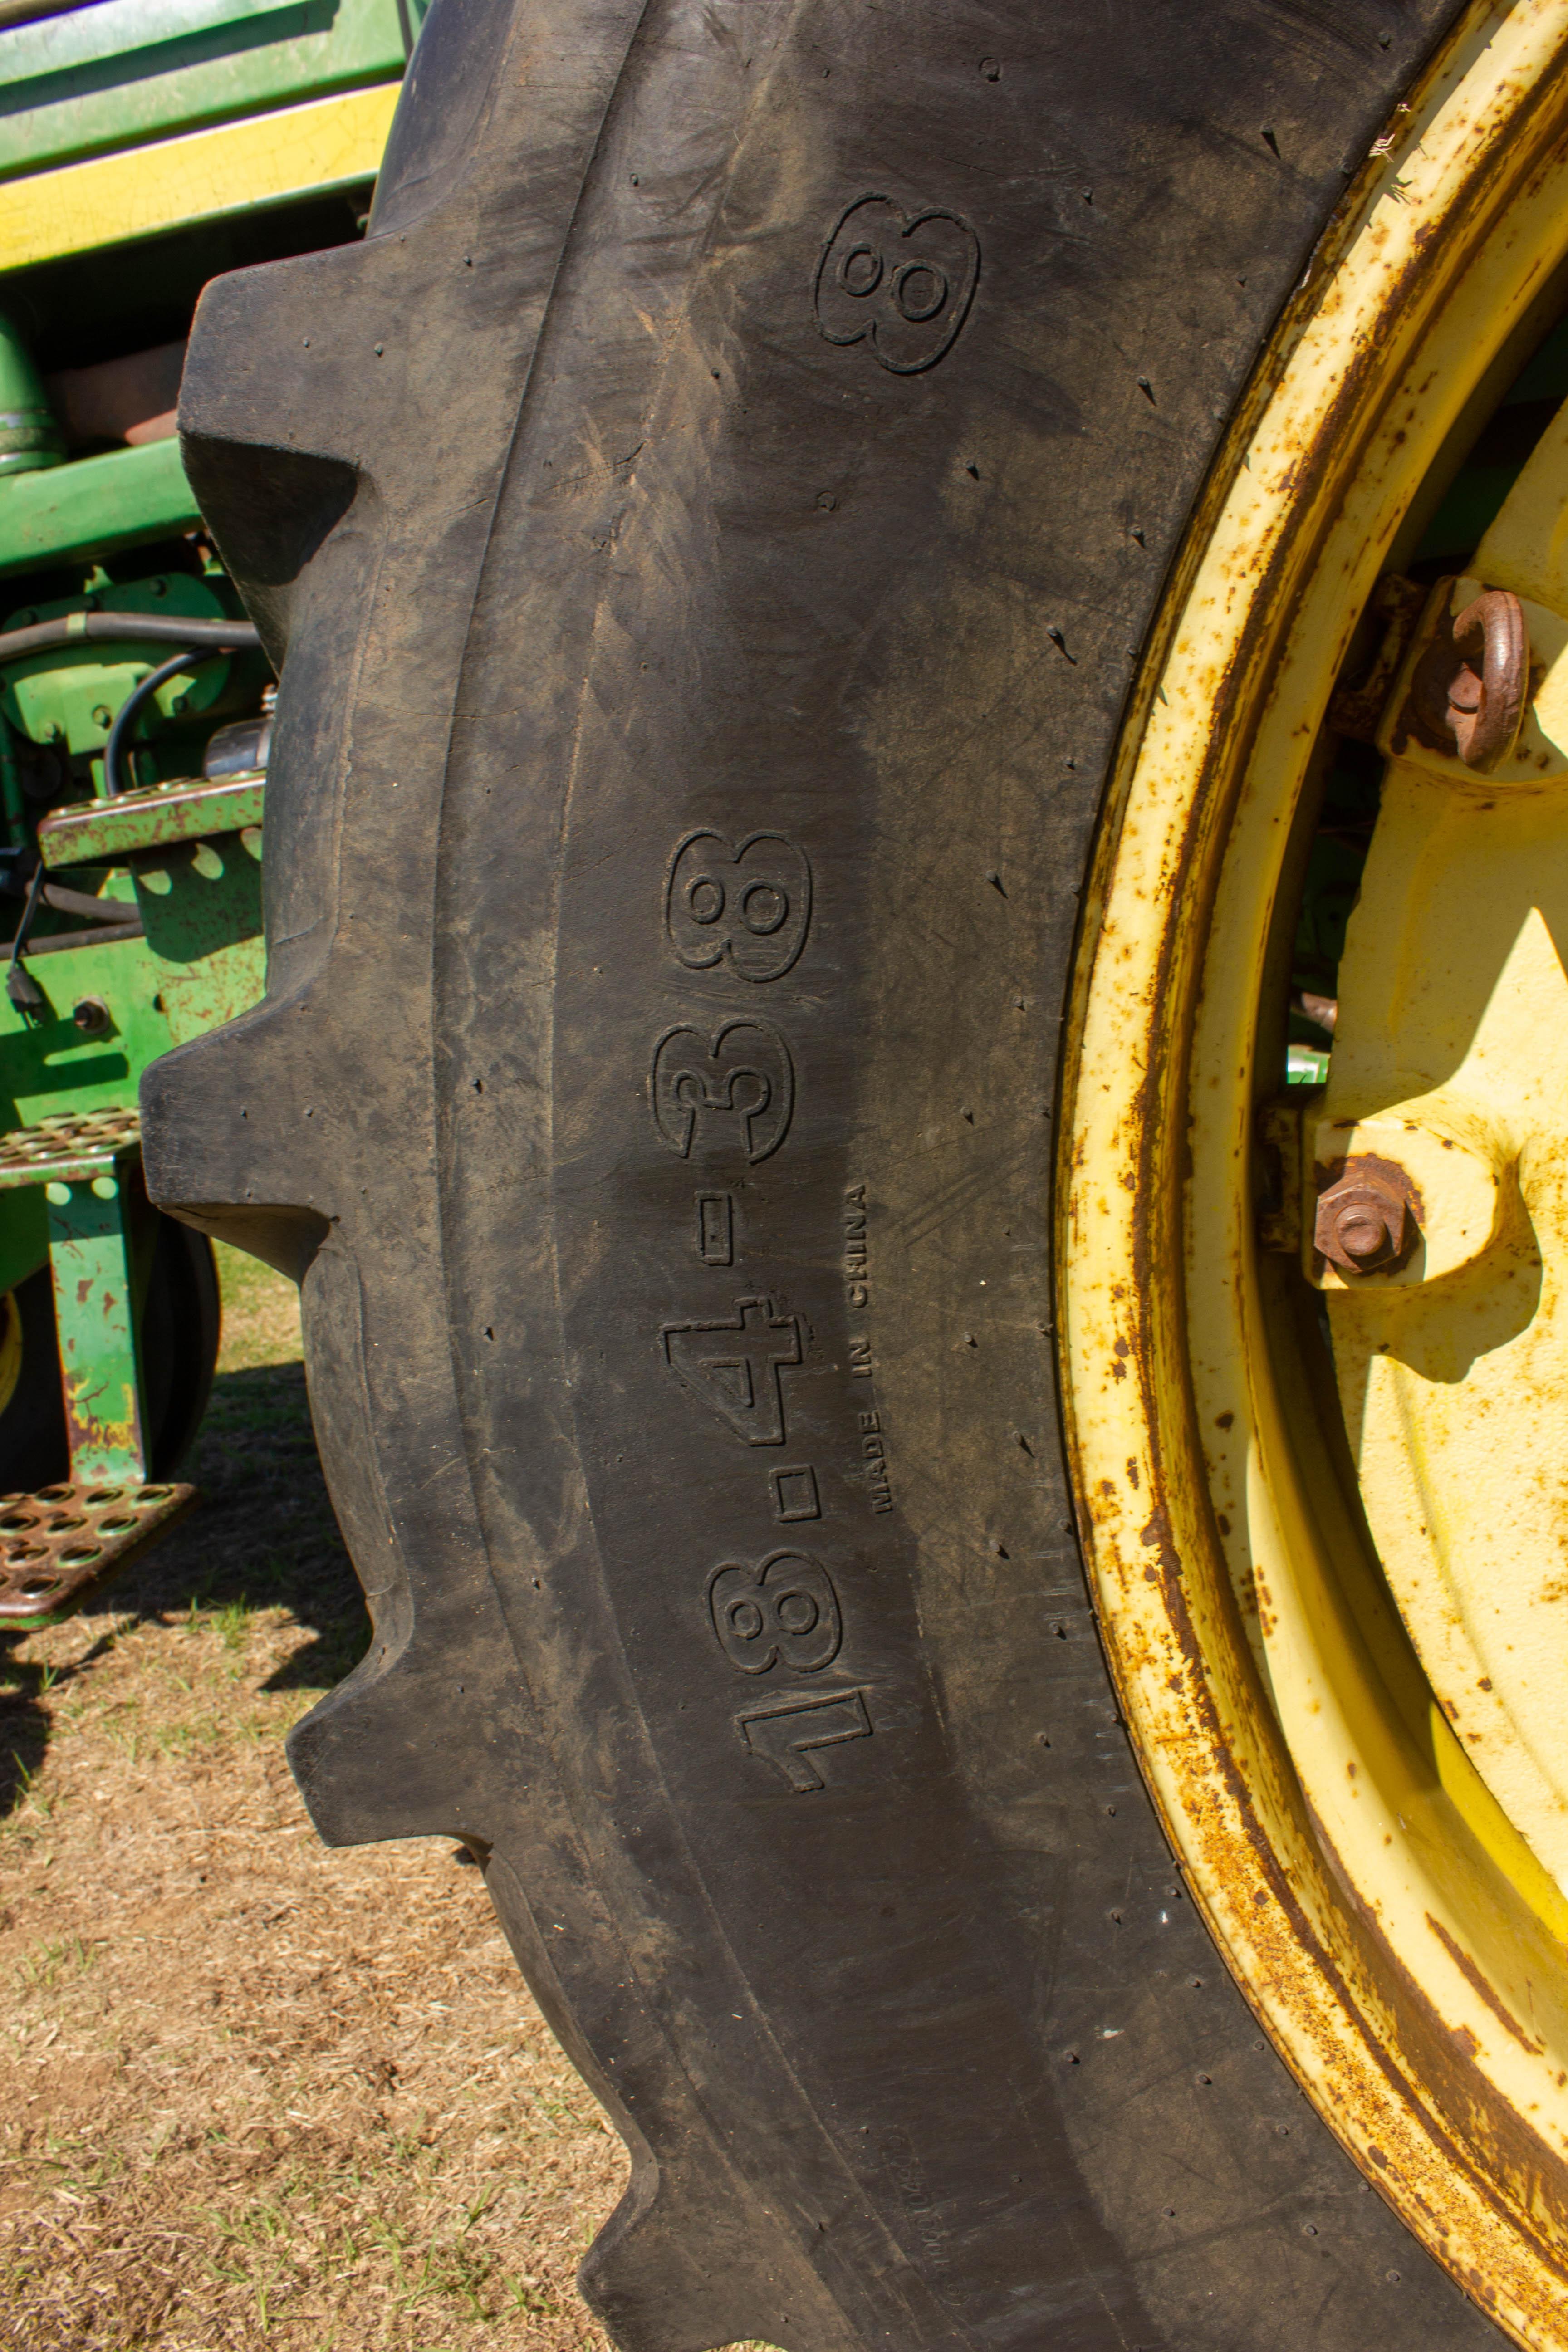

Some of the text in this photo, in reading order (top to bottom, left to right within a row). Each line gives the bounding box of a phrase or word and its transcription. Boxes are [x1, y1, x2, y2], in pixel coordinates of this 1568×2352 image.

[811, 192, 980, 376] 8
[844, 1185, 893, 1514] MADE IN CHINA
